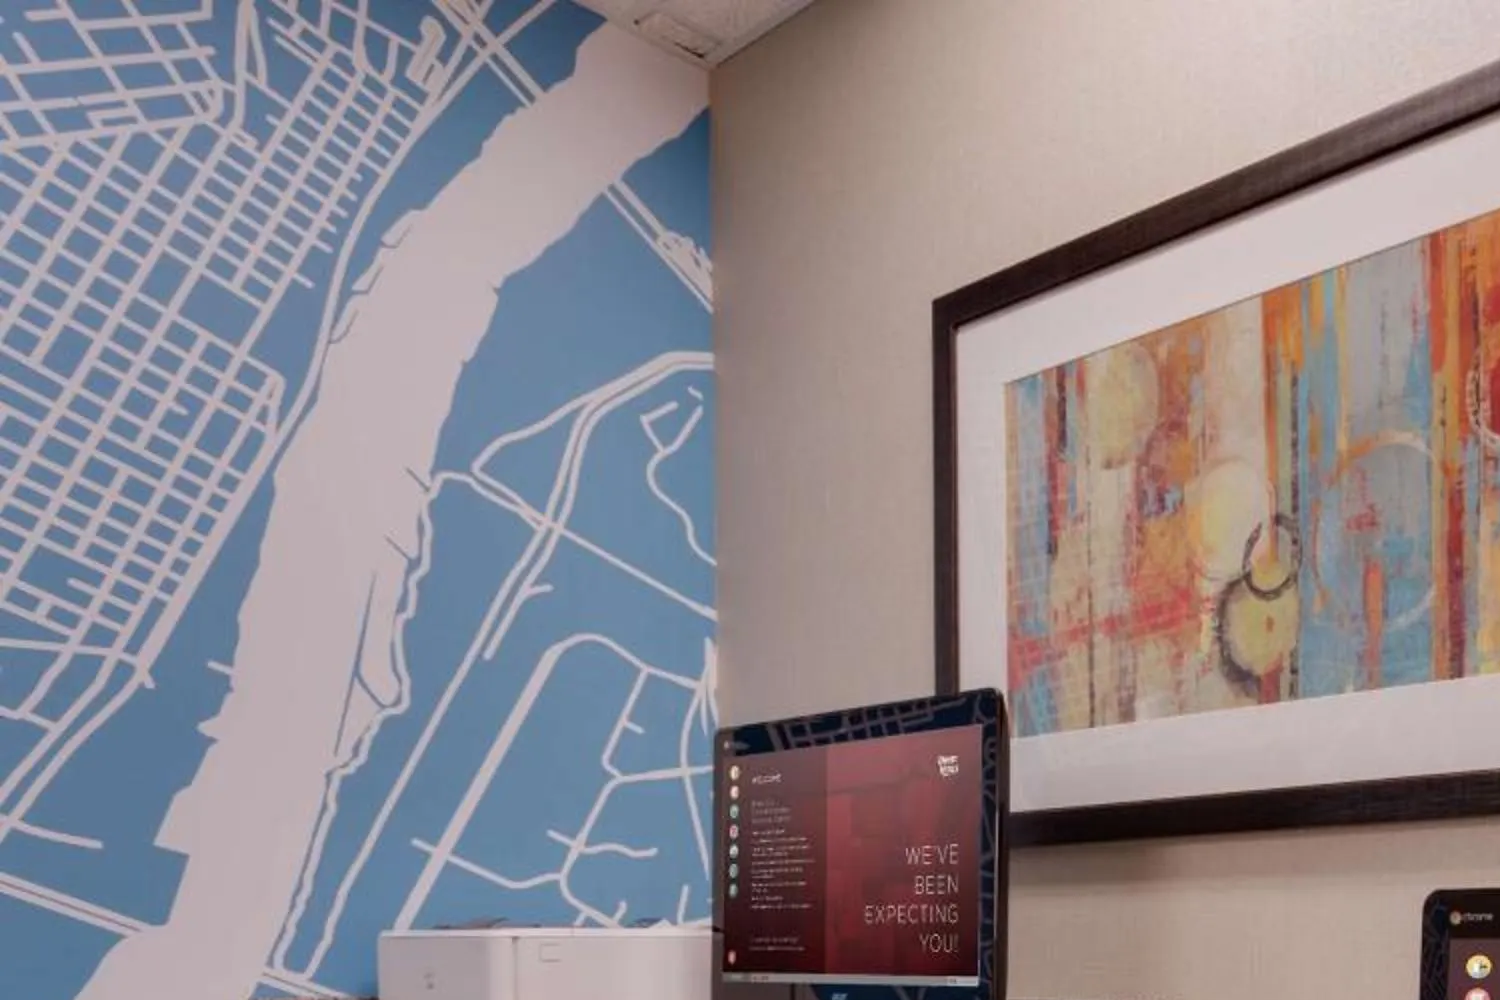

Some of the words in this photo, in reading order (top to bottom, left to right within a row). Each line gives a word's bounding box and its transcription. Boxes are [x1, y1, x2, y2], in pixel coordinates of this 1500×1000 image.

[914, 875, 959, 896] BEEN
[864, 902, 959, 925] EXPECTING
[918, 933, 959, 953] YOU!
